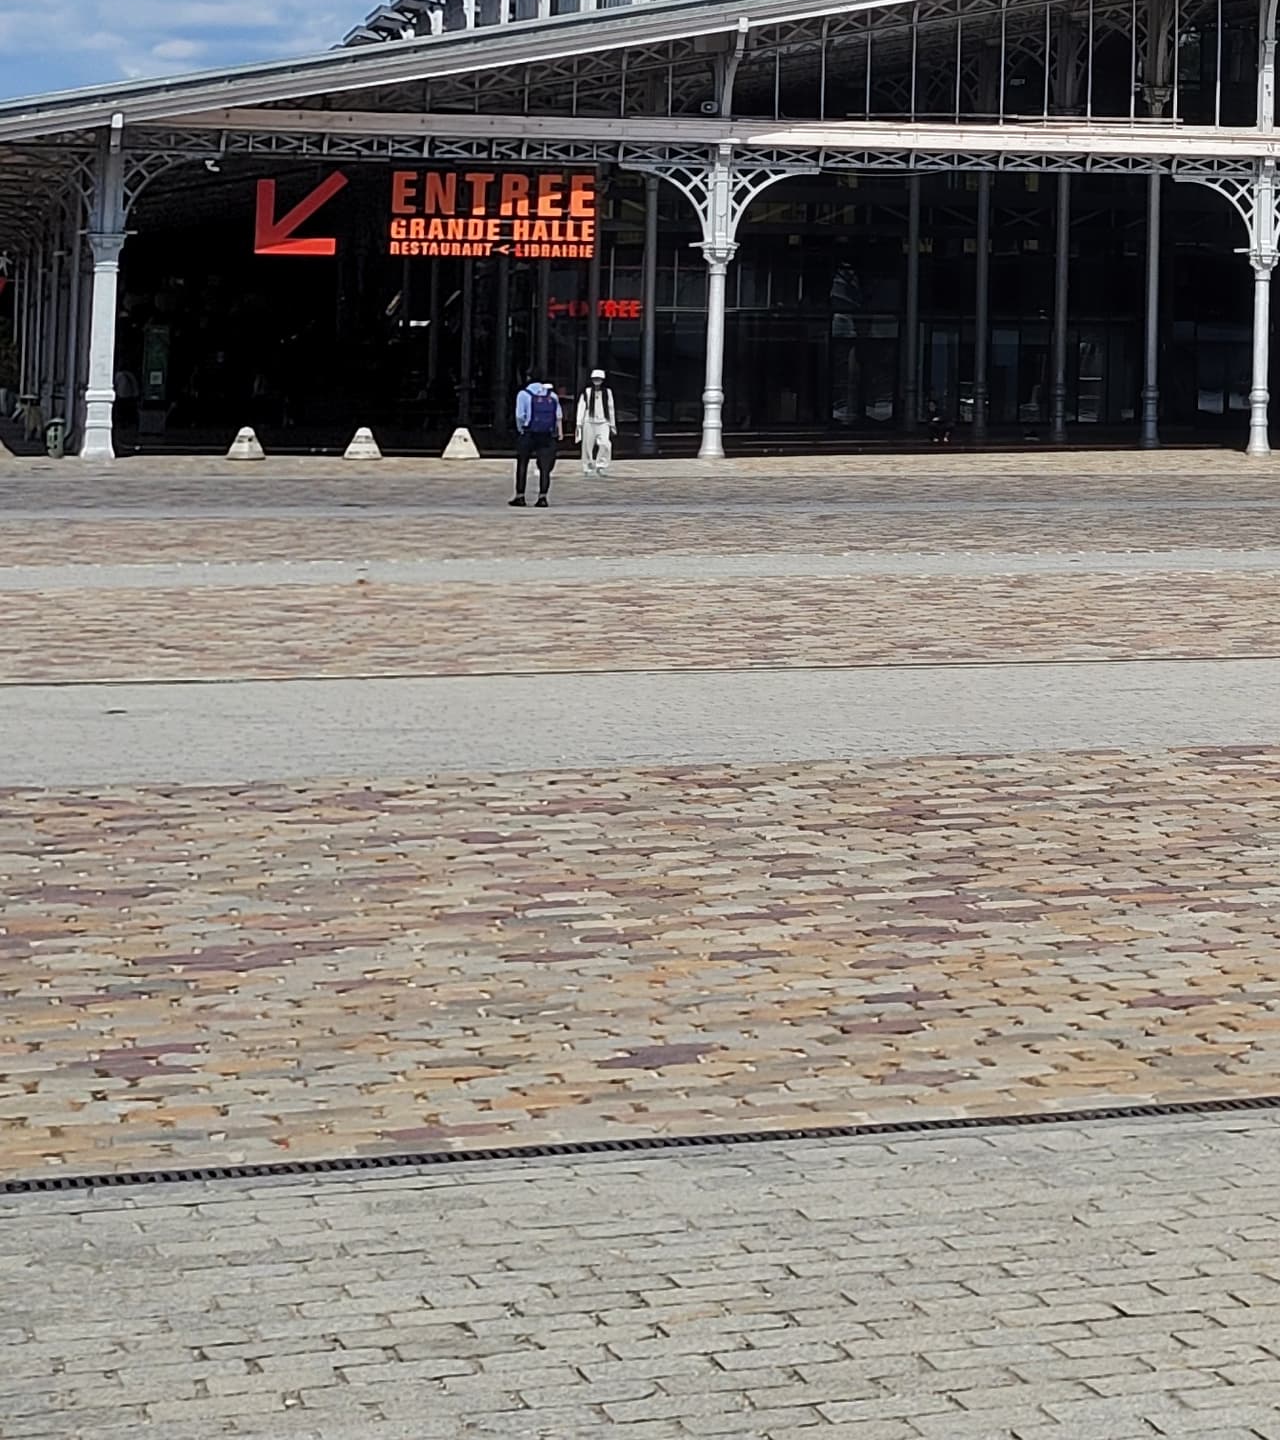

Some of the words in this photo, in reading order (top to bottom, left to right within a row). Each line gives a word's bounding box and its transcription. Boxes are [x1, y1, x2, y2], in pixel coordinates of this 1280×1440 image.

[391, 171, 595, 217] ENTREE
[391, 218, 500, 240] GRANDE
[513, 219, 595, 241] HALLE
[390, 241, 493, 256] RESTAURANT
[515, 244, 593, 258] LIBRAIRIE
